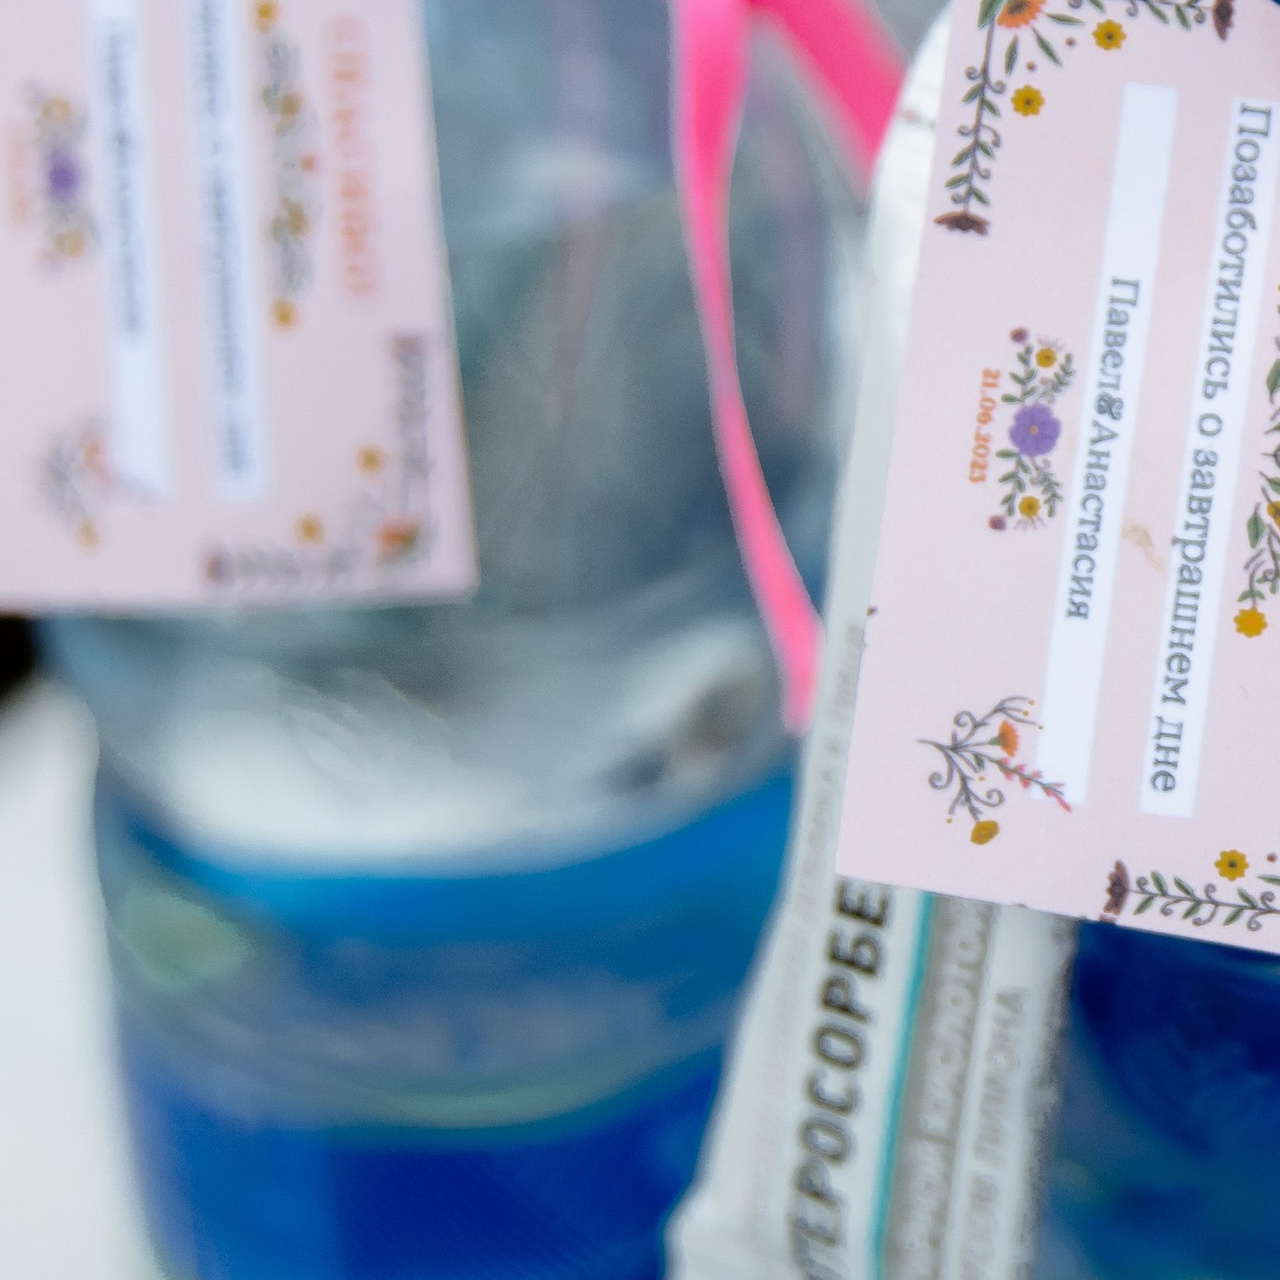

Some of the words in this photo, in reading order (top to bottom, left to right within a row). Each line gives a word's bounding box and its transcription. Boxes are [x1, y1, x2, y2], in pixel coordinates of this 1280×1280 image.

[1198, 102, 1272, 401] Позаботились
[968, 367, 1001, 484] 21.06.2023
[1066, 277, 1140, 621] Павел&Анастасия
[1198, 412, 1224, 438] о
[1161, 444, 1222, 708] завтрашнем
[1149, 715, 1185, 792] дне
